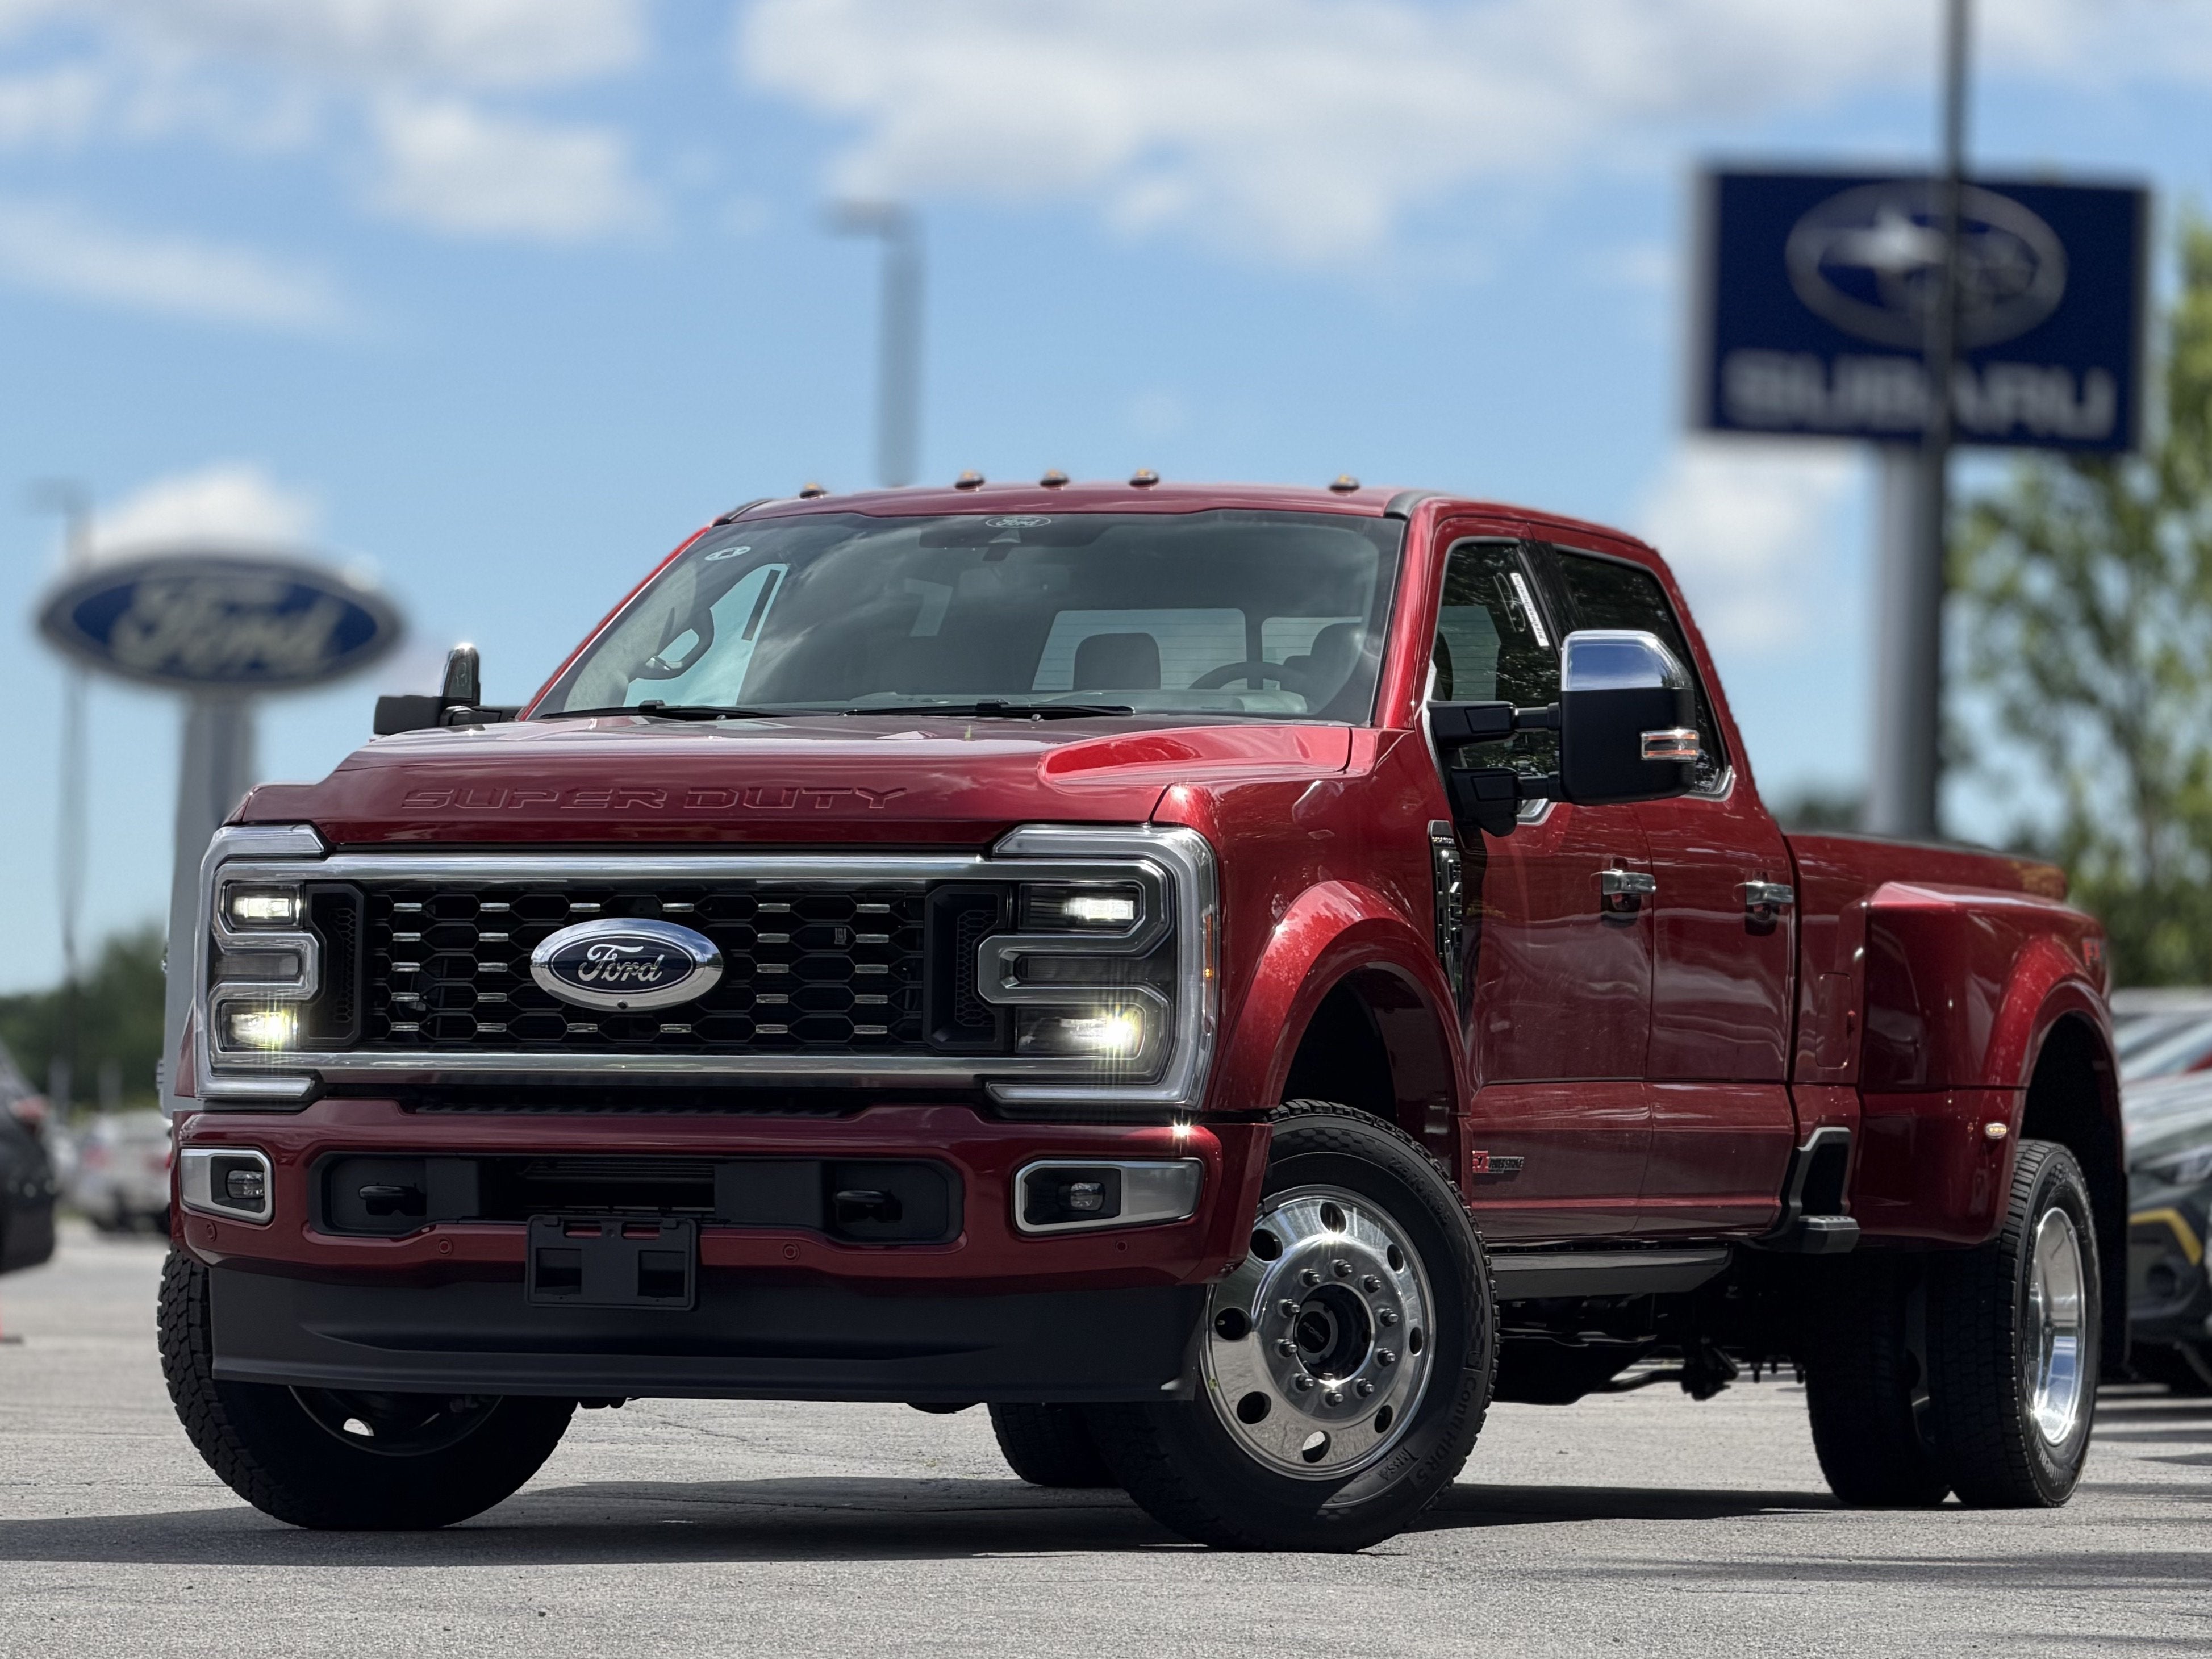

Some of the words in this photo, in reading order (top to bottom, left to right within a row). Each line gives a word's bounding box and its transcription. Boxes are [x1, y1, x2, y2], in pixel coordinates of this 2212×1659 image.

[996, 518, 1040, 526] Ford
[110, 577, 341, 675] Ford
[402, 788, 667, 810] SUPER
[684, 787, 908, 809] DUTY
[578, 944, 665, 982] Ford
[1450, 1376, 1476, 1431] Conti
[1425, 1431, 1458, 1471] HDR
